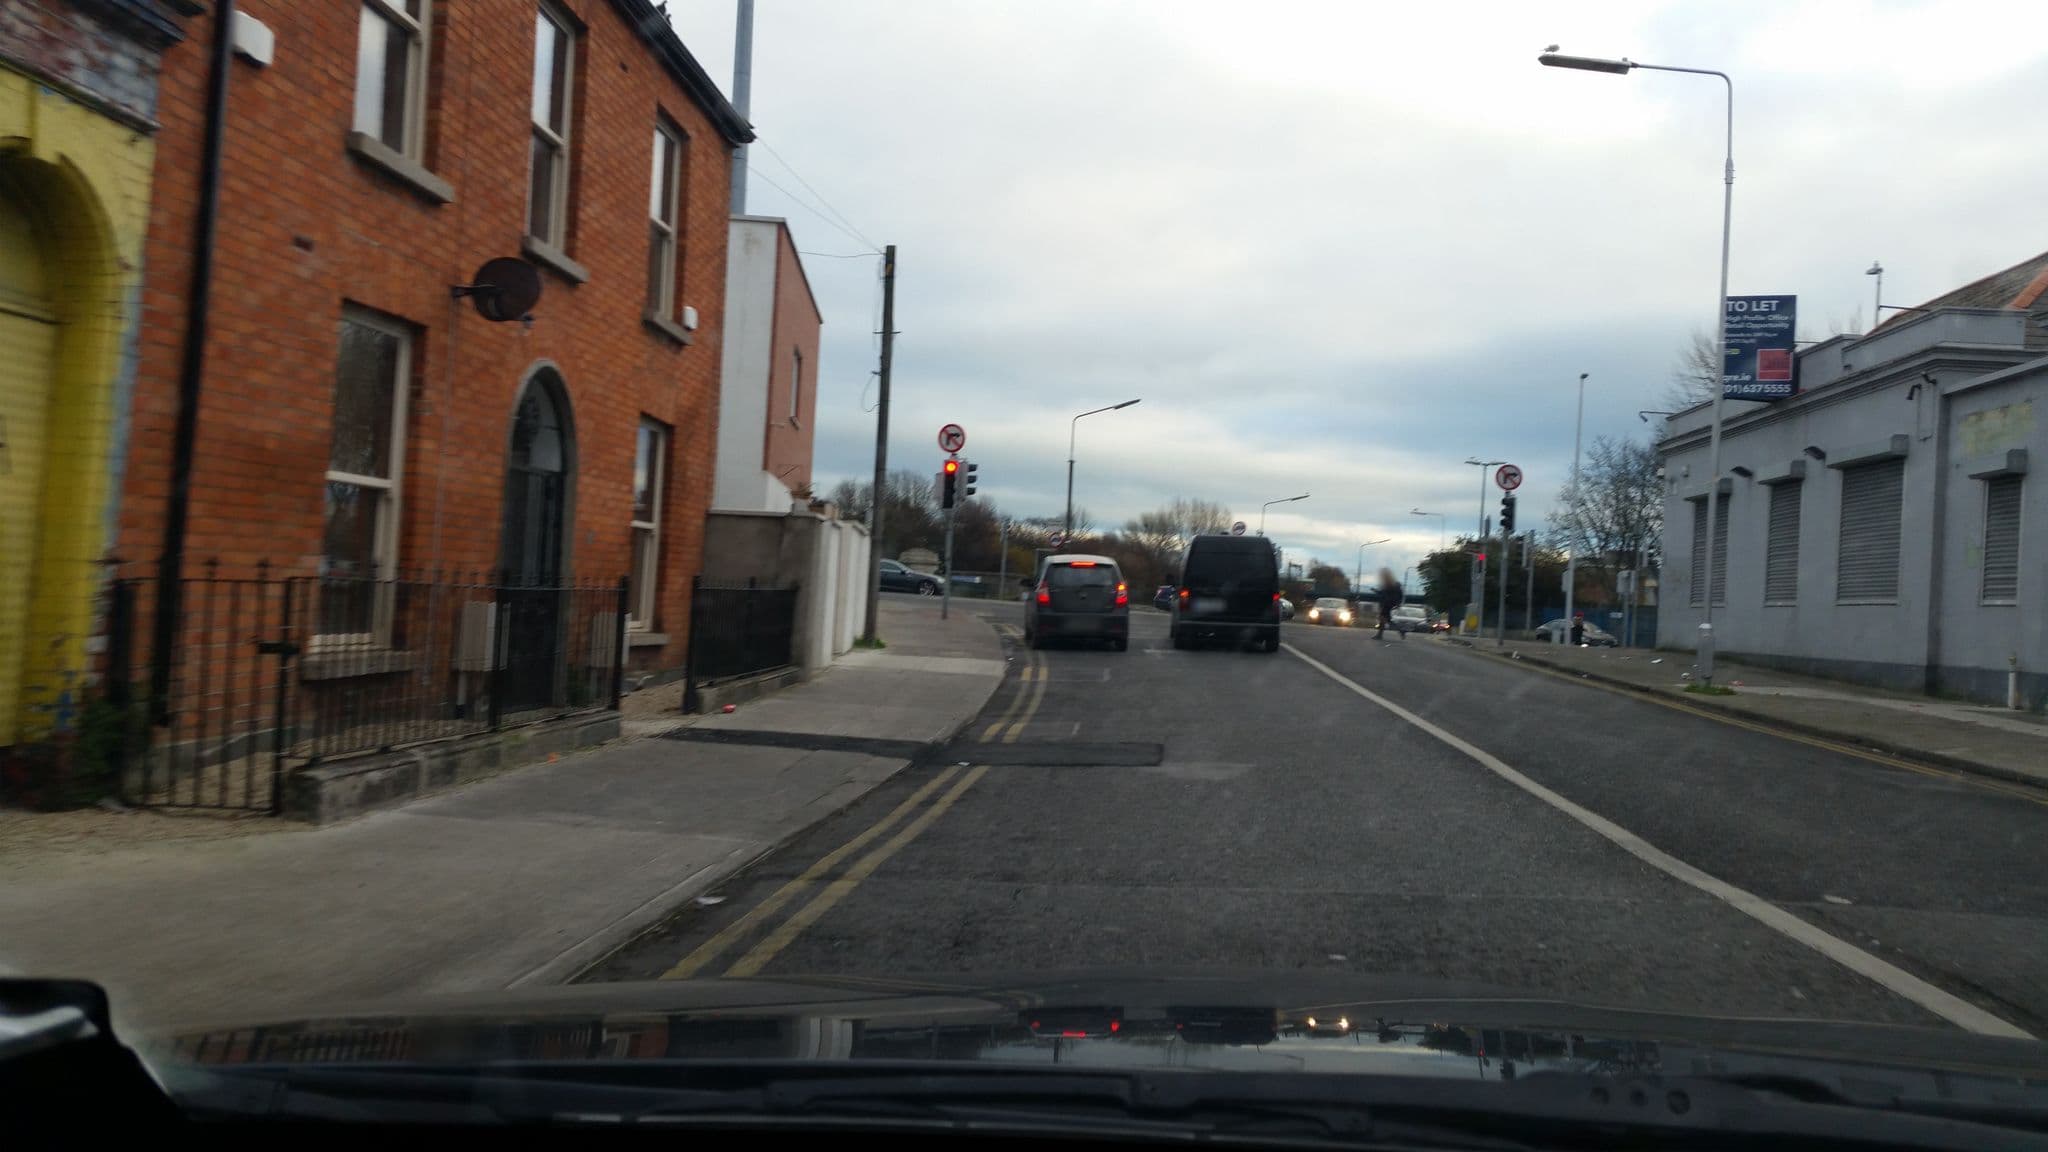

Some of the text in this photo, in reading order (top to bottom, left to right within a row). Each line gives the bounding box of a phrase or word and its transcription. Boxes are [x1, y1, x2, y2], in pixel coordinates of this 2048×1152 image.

[1726, 300, 1779, 311] TO LET
[1767, 313, 1789, 321] Office
